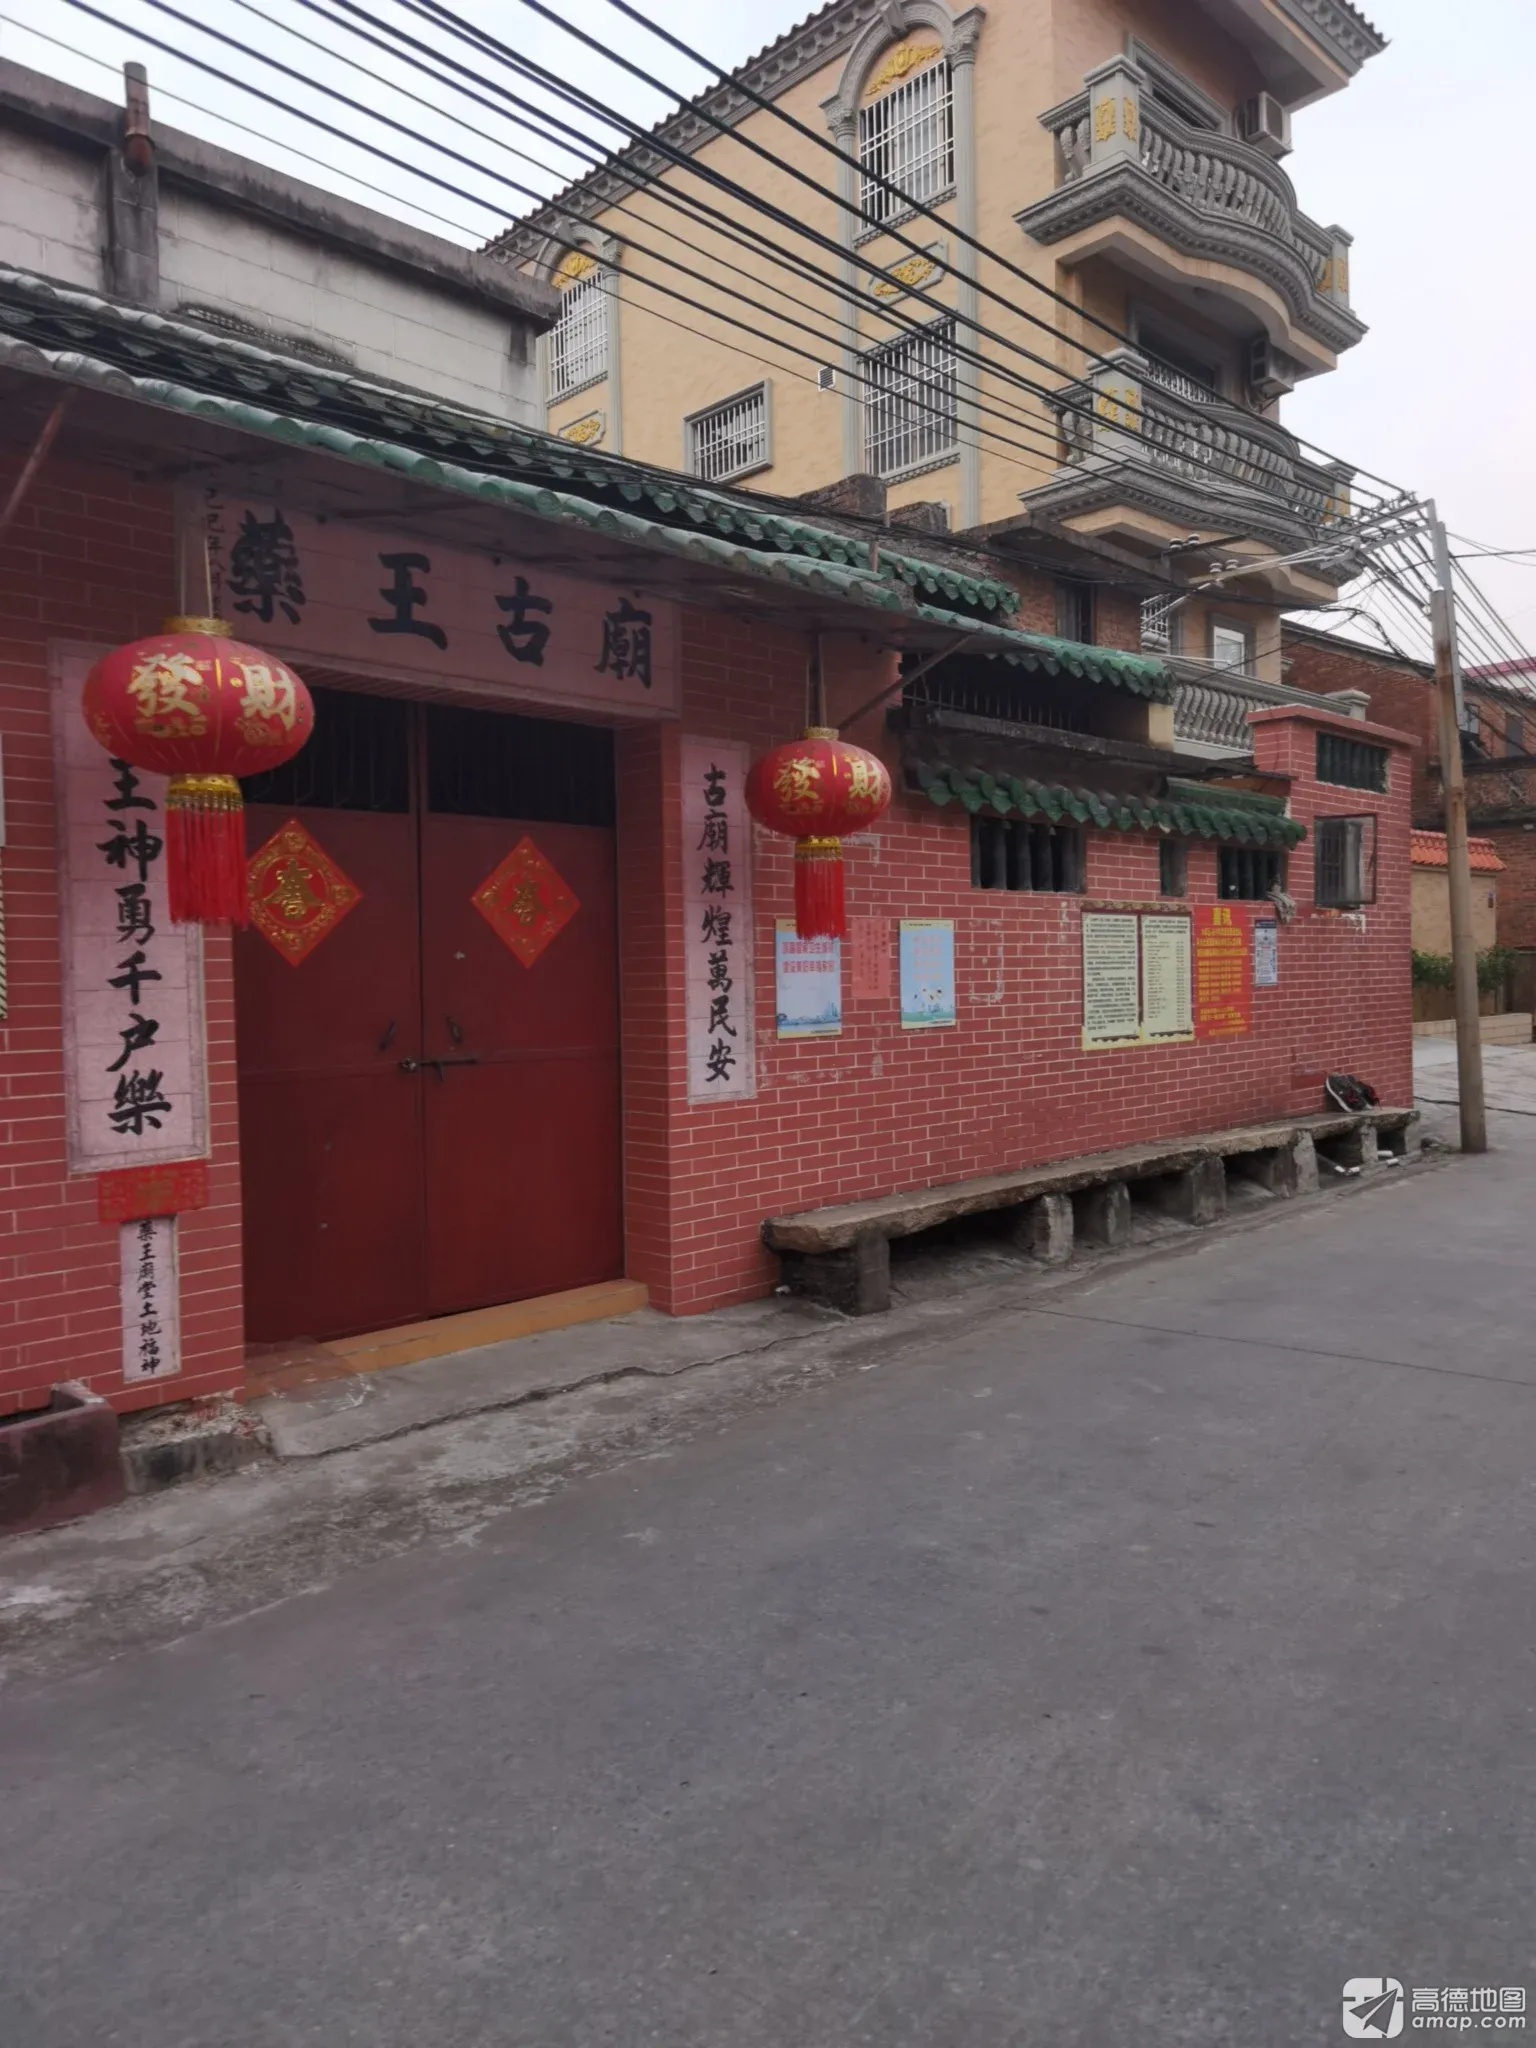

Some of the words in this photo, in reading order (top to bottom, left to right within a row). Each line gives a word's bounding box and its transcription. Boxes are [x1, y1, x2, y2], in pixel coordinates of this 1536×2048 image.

[226, 508, 652, 690] 藥王古廟
[127, 652, 296, 731] 發財
[773, 756, 881, 804] 發財
[697, 762, 738, 1084] 古廟輝煌萬民安
